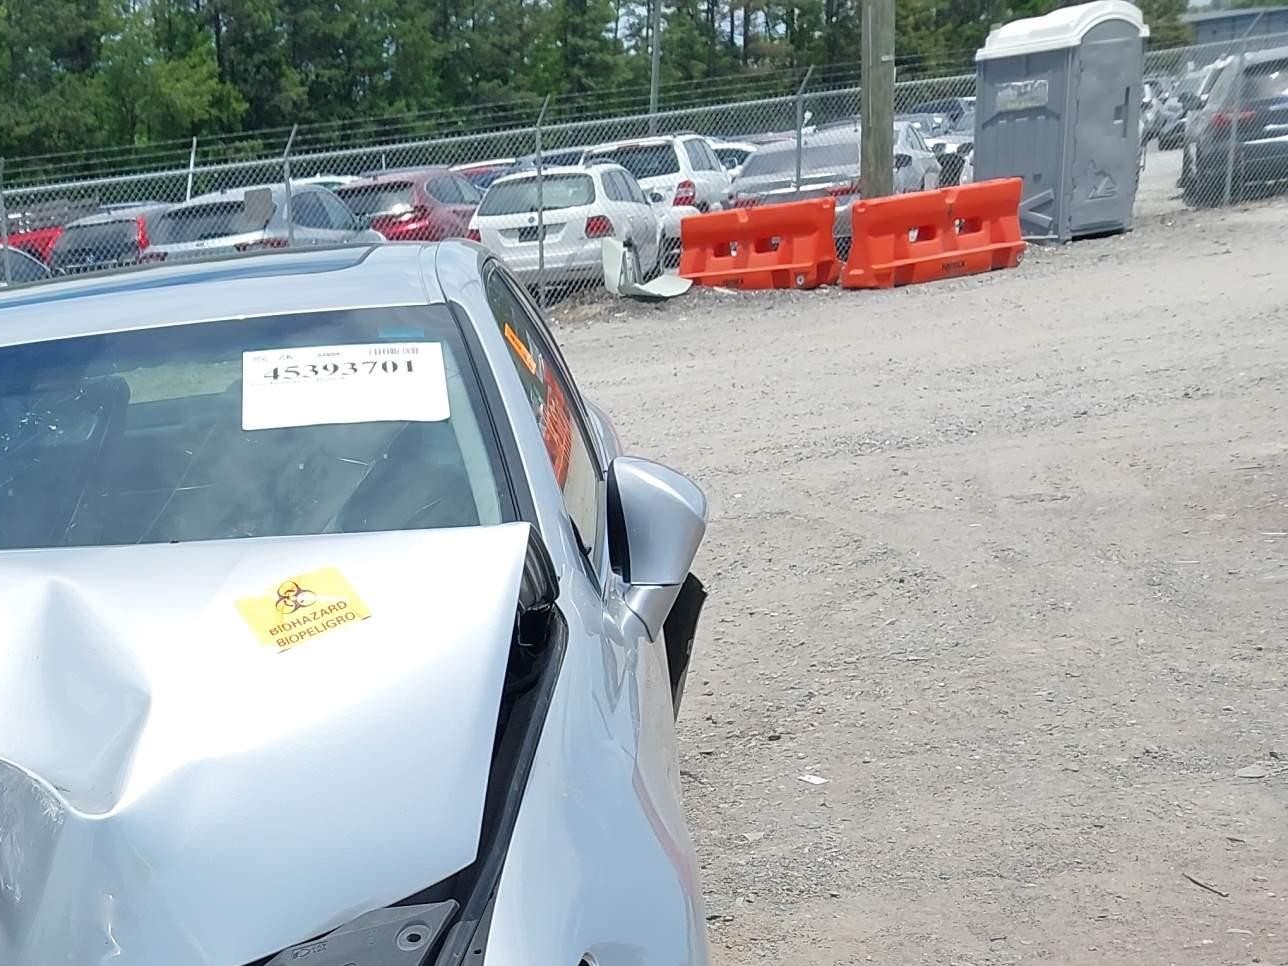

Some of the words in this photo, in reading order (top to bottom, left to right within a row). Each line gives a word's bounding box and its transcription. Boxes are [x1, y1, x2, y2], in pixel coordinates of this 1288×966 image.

[263, 360, 415, 381] 45393701
[268, 600, 348, 637] BIOHAZARD
[275, 611, 356, 648] BIOPELIGRO
